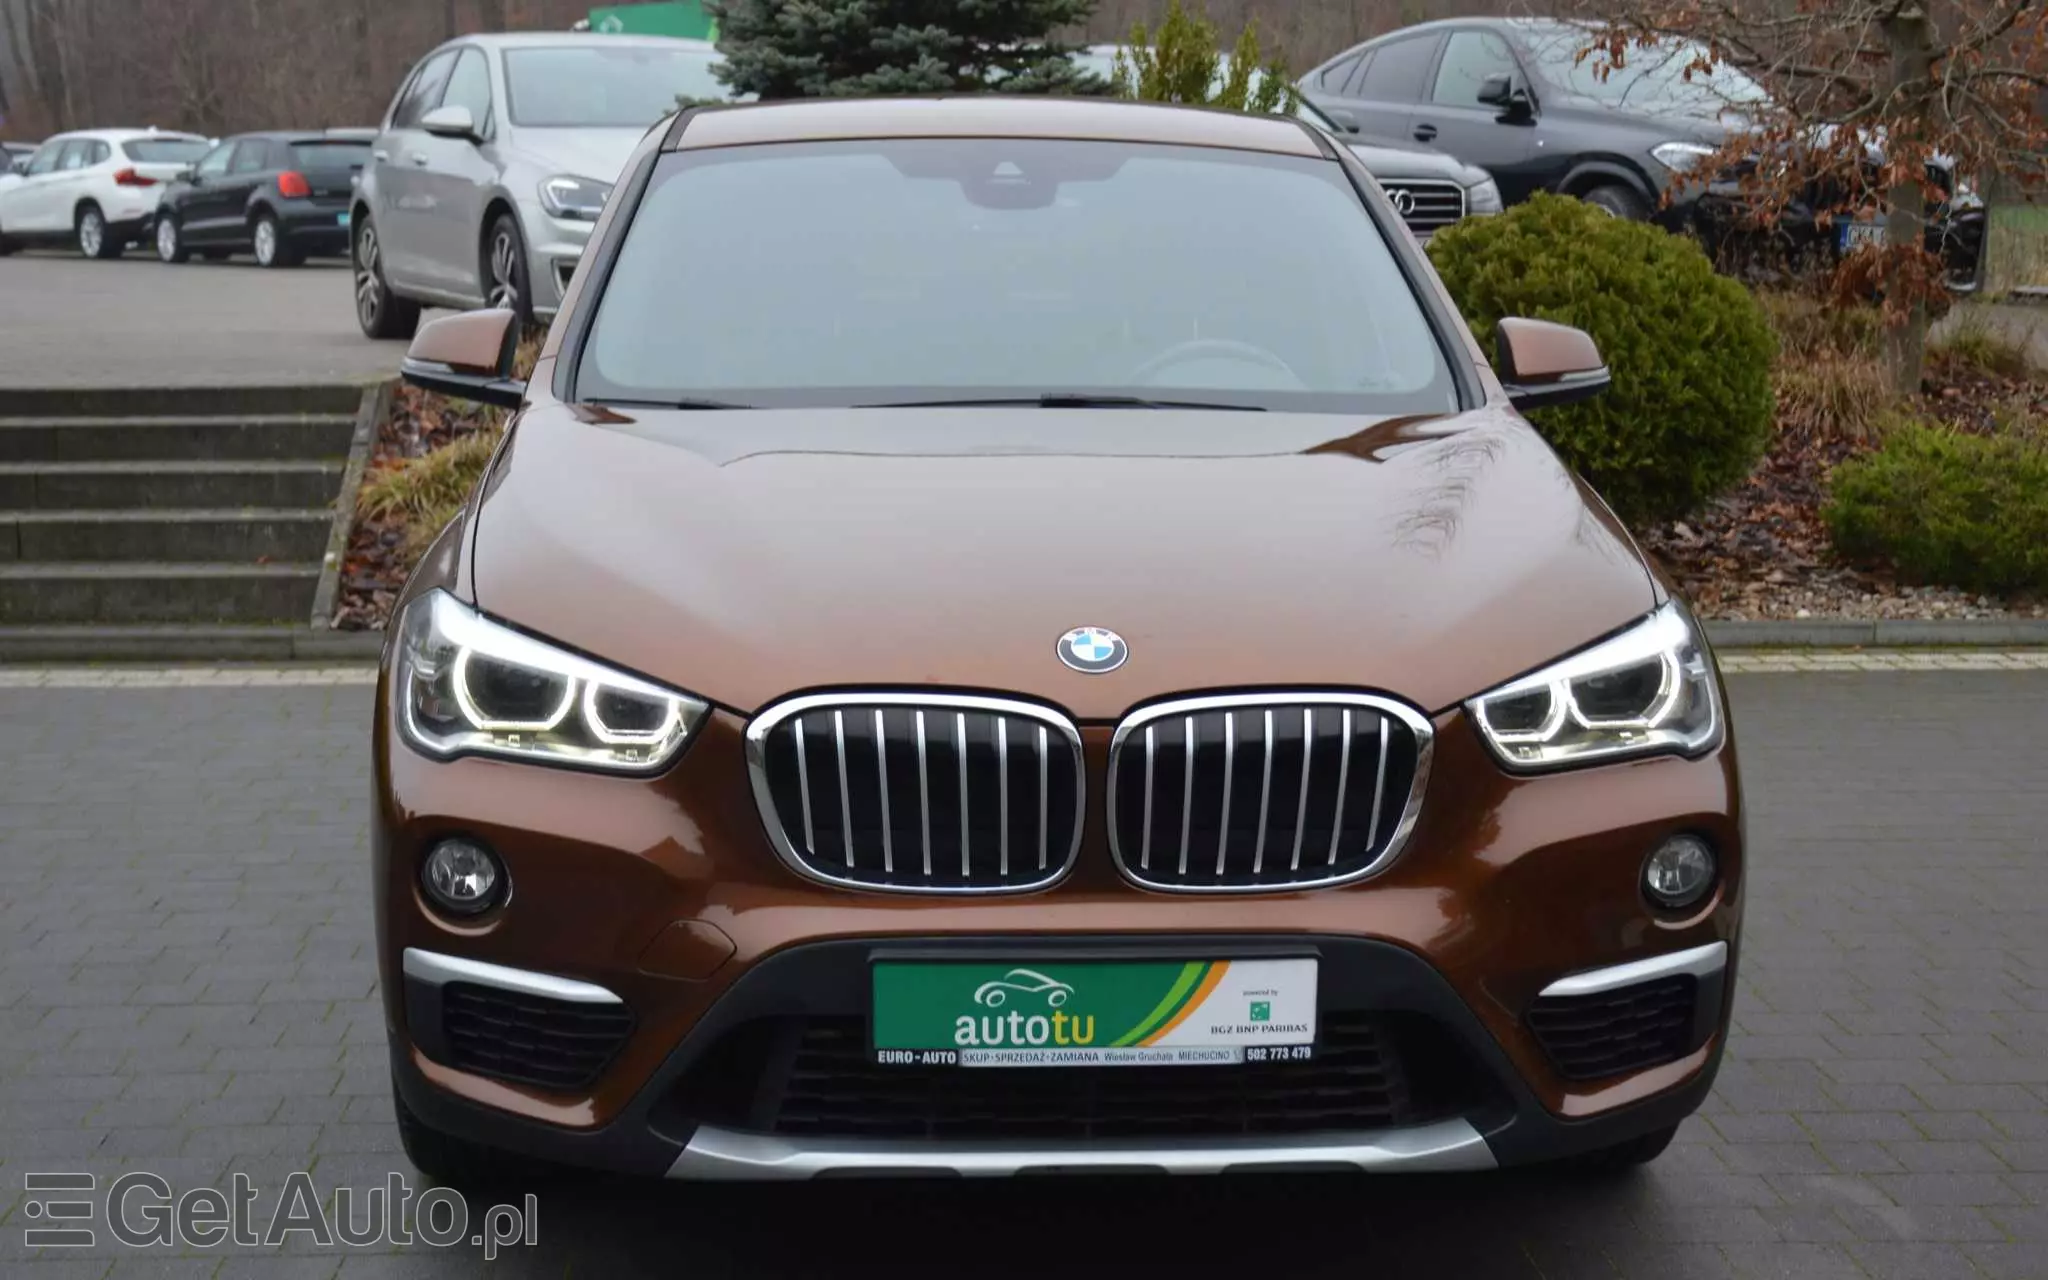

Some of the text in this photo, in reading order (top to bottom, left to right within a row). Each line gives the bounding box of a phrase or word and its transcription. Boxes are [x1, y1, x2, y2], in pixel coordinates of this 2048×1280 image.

[954, 1010, 1094, 1045] autotu
[1236, 1025, 1259, 1033] BNP
[1261, 1024, 1308, 1033] PARIBAS
[1178, 1050, 1230, 1061] MIECHUCINO
[1247, 1048, 1267, 1061] 502
[1270, 1047, 1289, 1060] 773
[1292, 1046, 1311, 1059] 479
